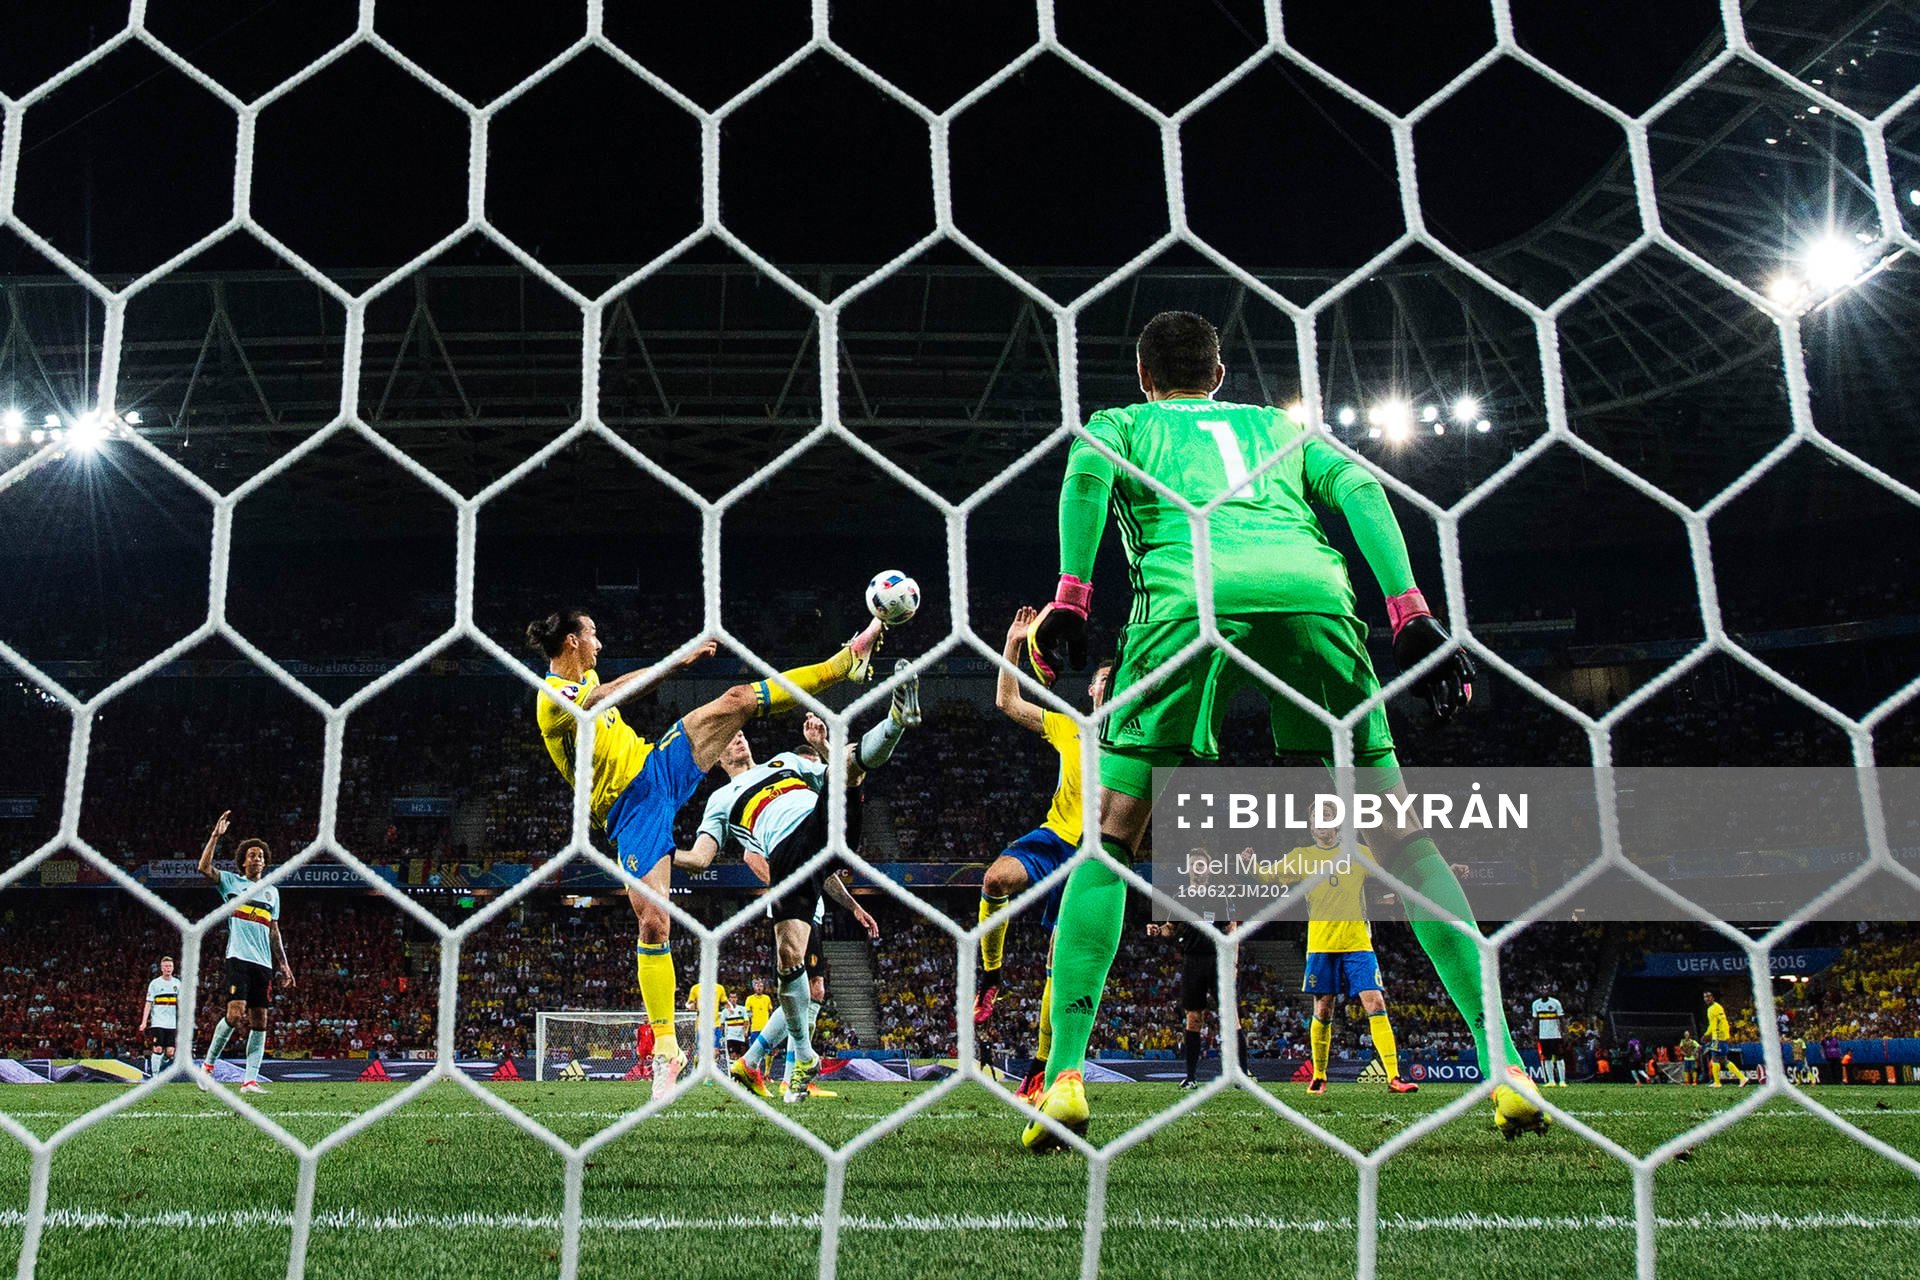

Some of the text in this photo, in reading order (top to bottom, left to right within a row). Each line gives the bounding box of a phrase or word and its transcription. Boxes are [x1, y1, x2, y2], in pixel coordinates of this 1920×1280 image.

[1196, 420, 1255, 498] 1
[304, 870, 340, 881] EURO
[1677, 959, 1720, 972] UEFA
[1768, 955, 1806, 969] 2016
[1428, 1066, 1479, 1079] NO TO
